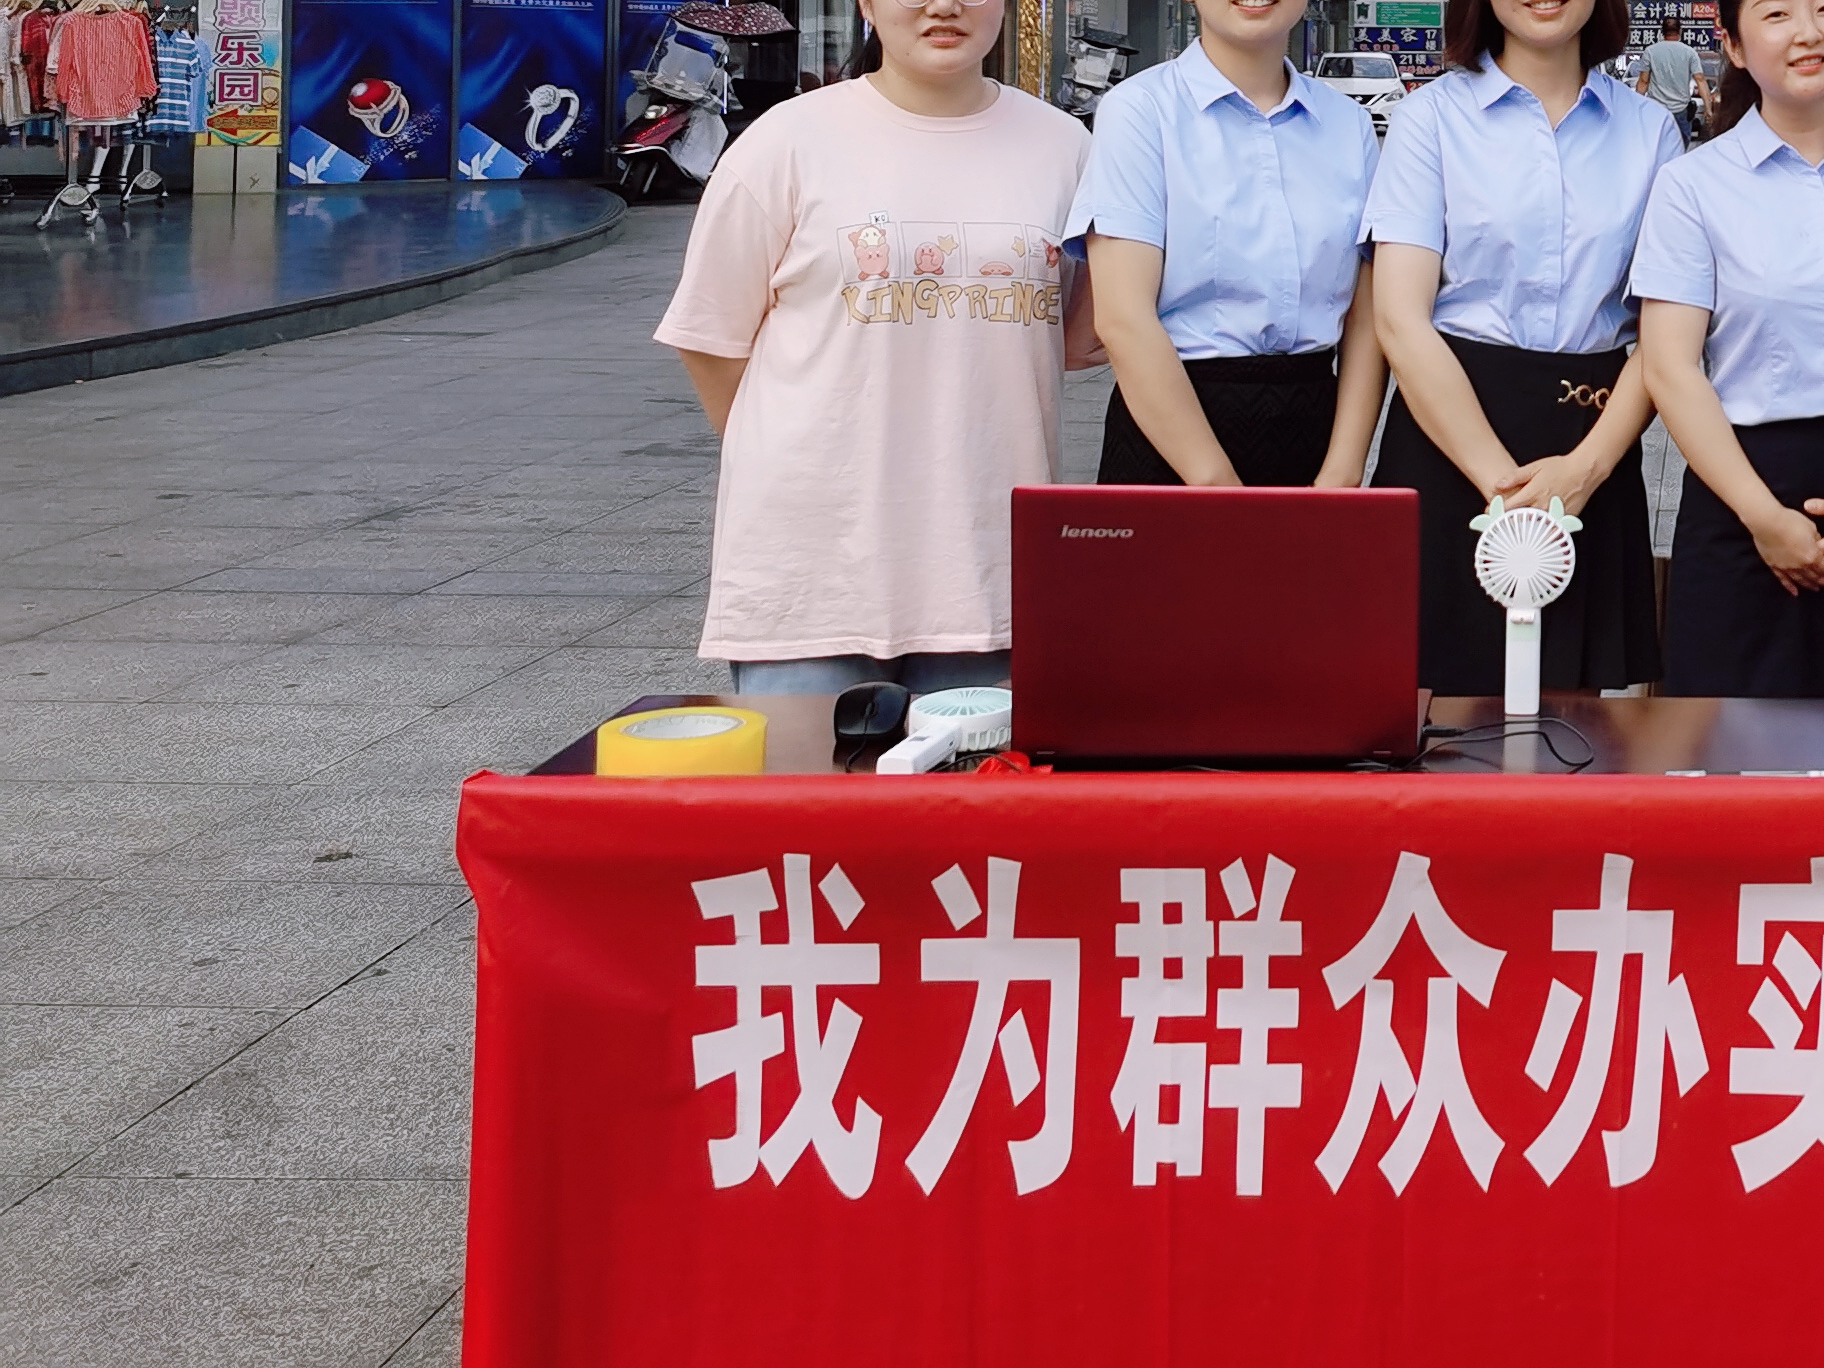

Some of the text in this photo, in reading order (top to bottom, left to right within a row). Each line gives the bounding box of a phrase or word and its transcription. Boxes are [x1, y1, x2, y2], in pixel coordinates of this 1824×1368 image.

[1628, 1, 1692, 19] 会计培训
[1061, 524, 1134, 539] lenovo
